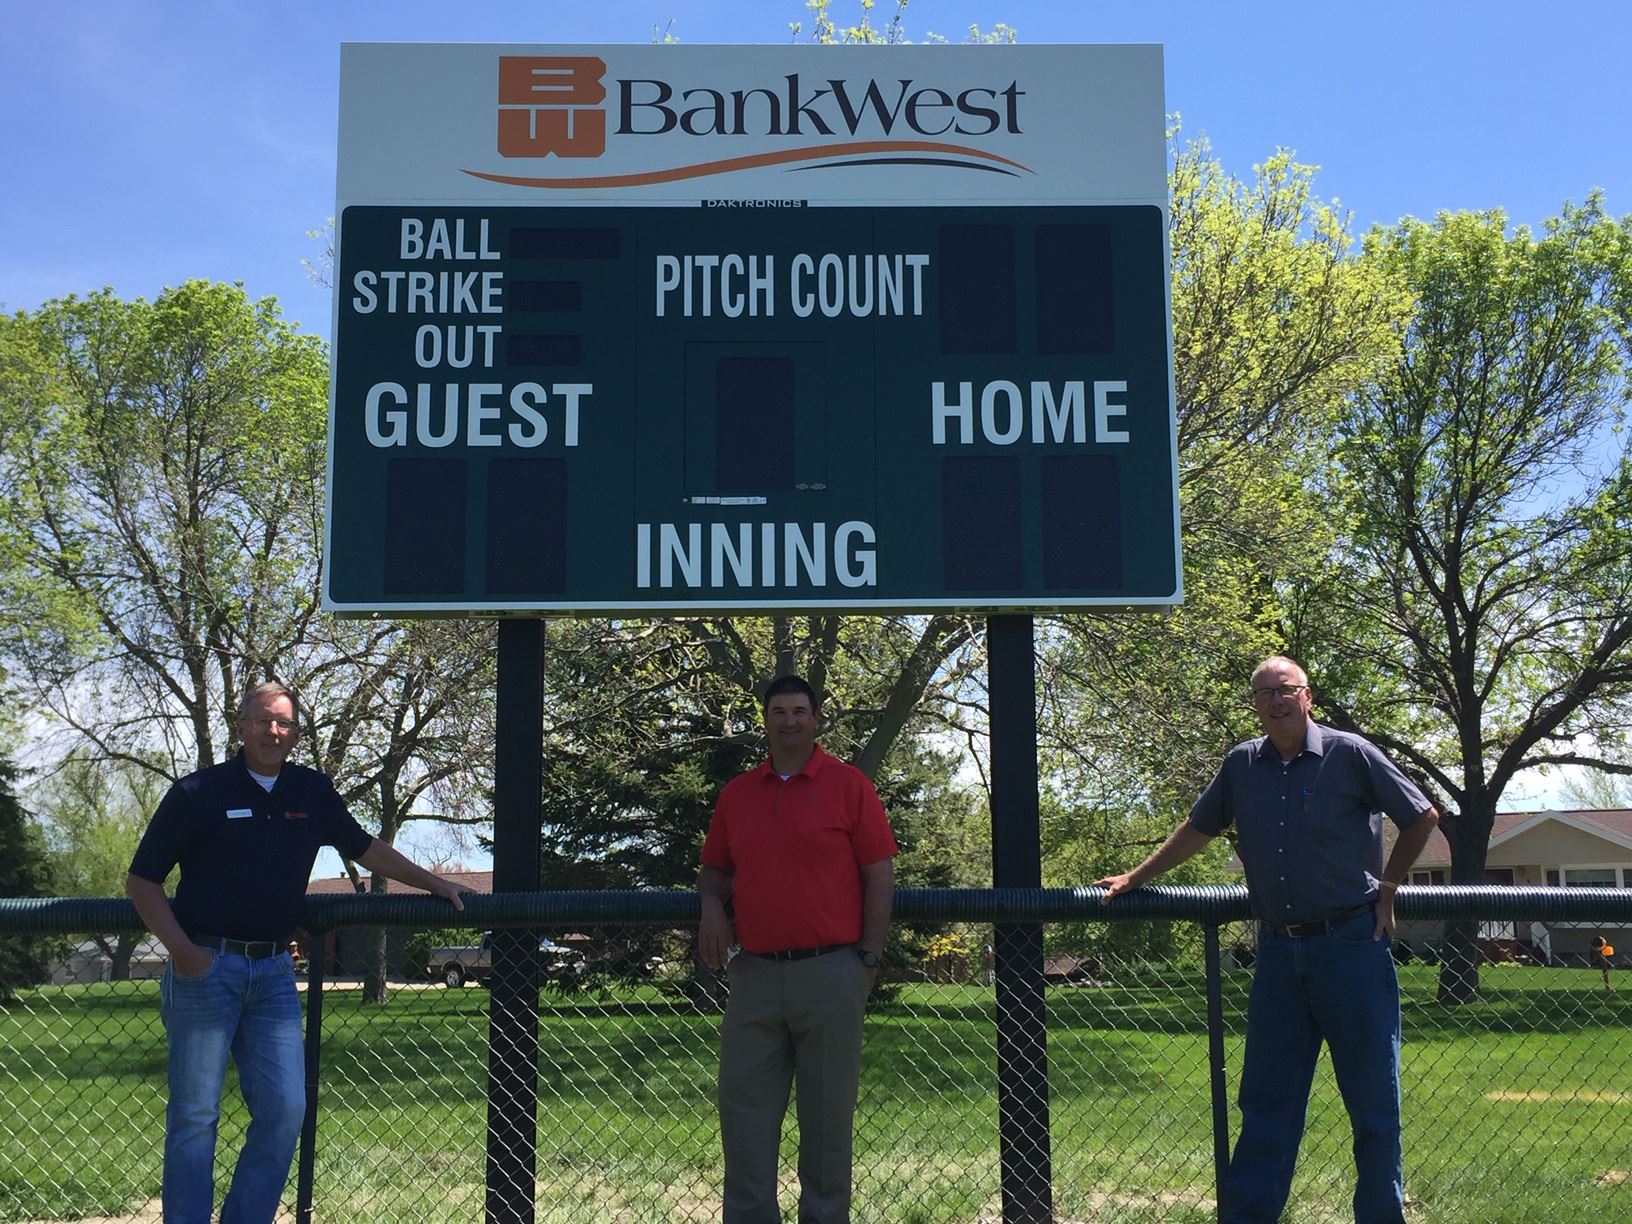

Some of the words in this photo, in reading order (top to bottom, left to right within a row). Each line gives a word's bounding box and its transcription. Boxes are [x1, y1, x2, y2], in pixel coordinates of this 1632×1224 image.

[615, 74, 1026, 136] BankWest
[707, 200, 802, 208] DAKTRONICS
[401, 219, 500, 259] BALL
[354, 271, 503, 313] STRIKE
[657, 254, 773, 317] PITCH
[792, 254, 929, 317] COUNT
[416, 325, 501, 367] OUT
[366, 383, 592, 447] GUEST
[932, 381, 1129, 444] HOME
[638, 521, 876, 587] INNING
